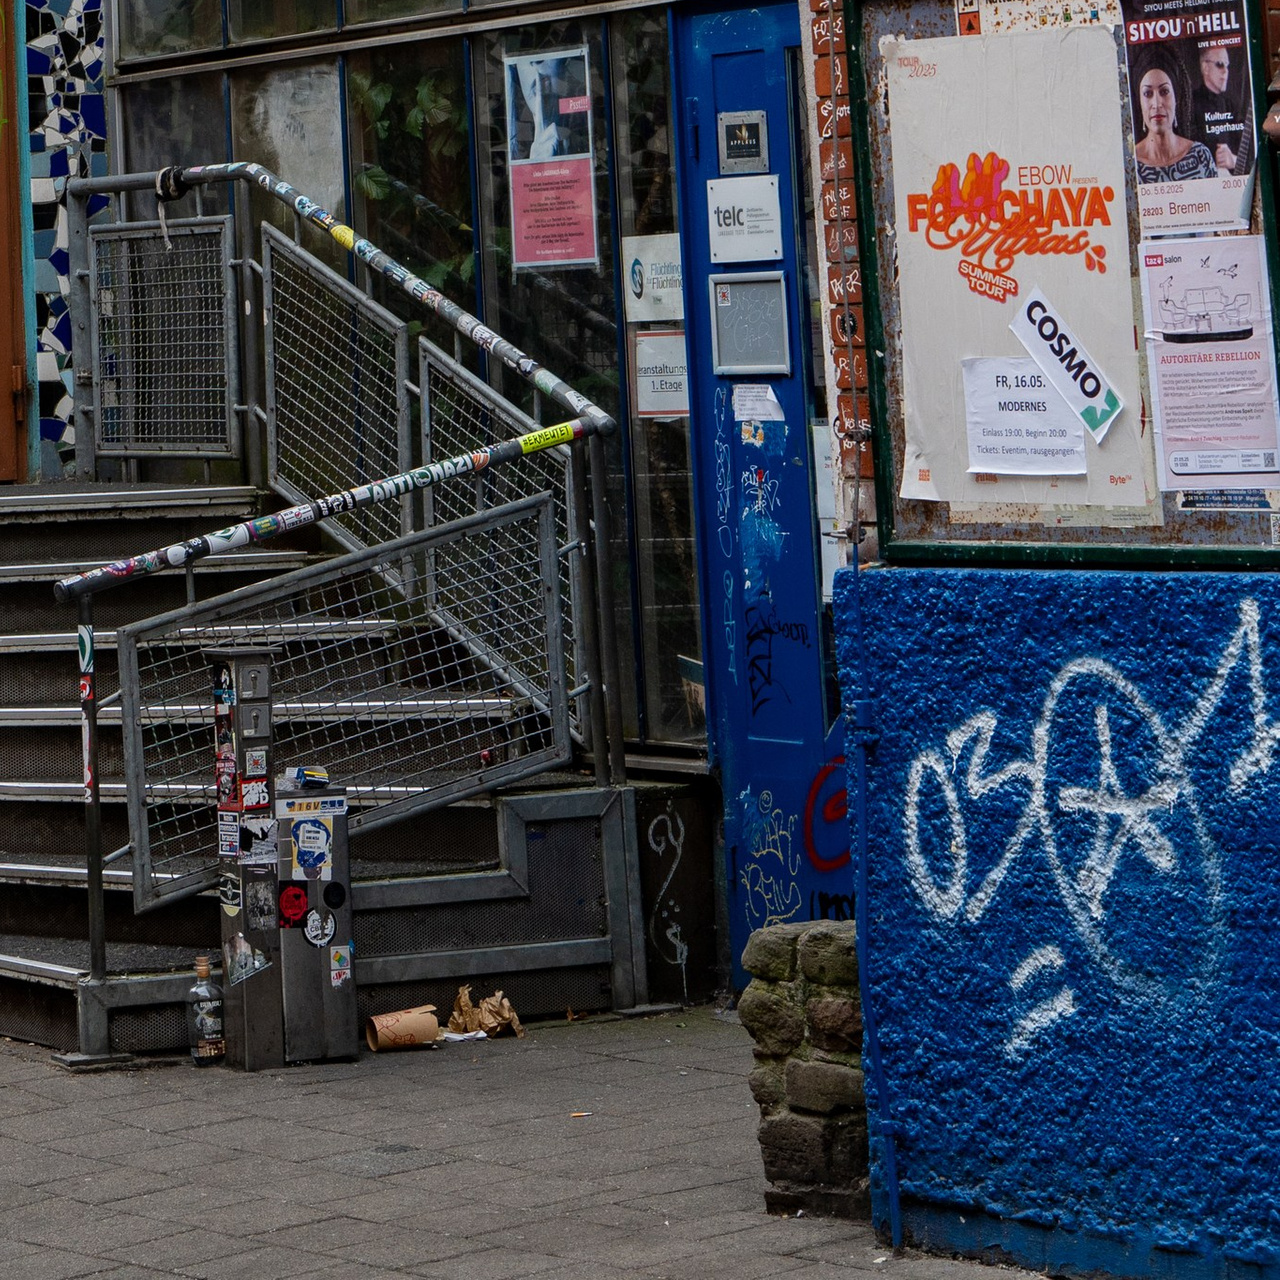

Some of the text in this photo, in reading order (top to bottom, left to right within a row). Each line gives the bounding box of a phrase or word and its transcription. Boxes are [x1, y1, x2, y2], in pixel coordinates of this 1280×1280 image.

[1144, 2, 1162, 12] SIYOU
[1164, 0, 1183, 9] MEETS
[1218, 37, 1241, 46] CONCERT
[897, 56, 919, 68] TOUR
[907, 63, 937, 78] 2025
[1205, 111, 1233, 122] Kulturz.
[1206, 122, 1244, 134] Lagerhaus
[1018, 164, 1071, 186] EBOW
[1141, 188, 1151, 196] Do.
[1154, 185, 1183, 195] 5.6.2025
[1222, 180, 1242, 189] 20.00
[1142, 202, 1210, 216] 28203 Bremen
[714, 206, 744, 227] telc
[1165, 255, 1182, 264] salon
[960, 262, 1016, 292] SUMMER
[970, 276, 1004, 299] TOUR
[1026, 300, 1101, 399] COSMO
[1161, 351, 1261, 364] AUTORITÄRE REBELLION
[660, 380, 682, 391] Etage
[996, 375, 1046, 390] FR, 16.05.
[998, 401, 1047, 412] MODERNES
[982, 428, 1067, 438] Einlass 19:00, Beginn 20:00
[977, 445, 1074, 457] Tickets: Eventim, rausgegangen
[373, 453, 473, 503] ANTI NAZI
